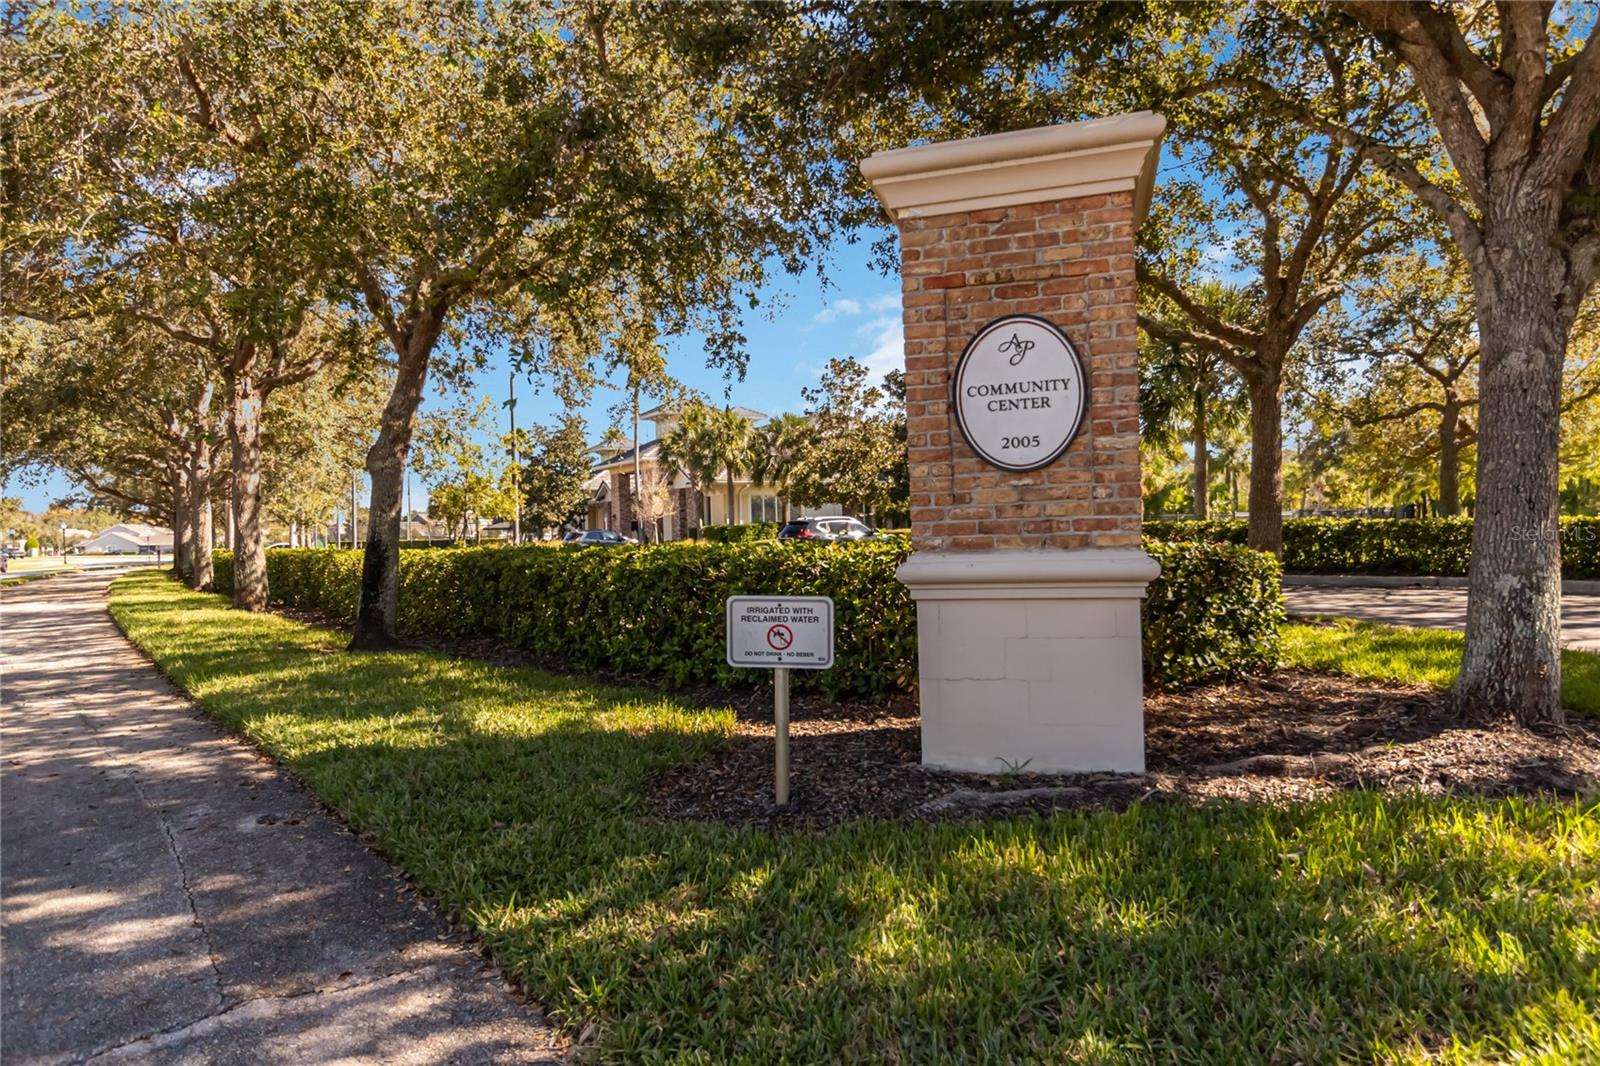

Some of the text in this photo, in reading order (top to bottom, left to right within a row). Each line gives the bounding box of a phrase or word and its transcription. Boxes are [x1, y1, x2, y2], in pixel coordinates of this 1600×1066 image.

[967, 378, 1071, 397] COMMUNITY
[987, 396, 1051, 412] CENTER
[1001, 435, 1040, 449] 2005
[746, 606, 790, 614] IRRIGATED
[740, 615, 789, 623] RECLAIMED
